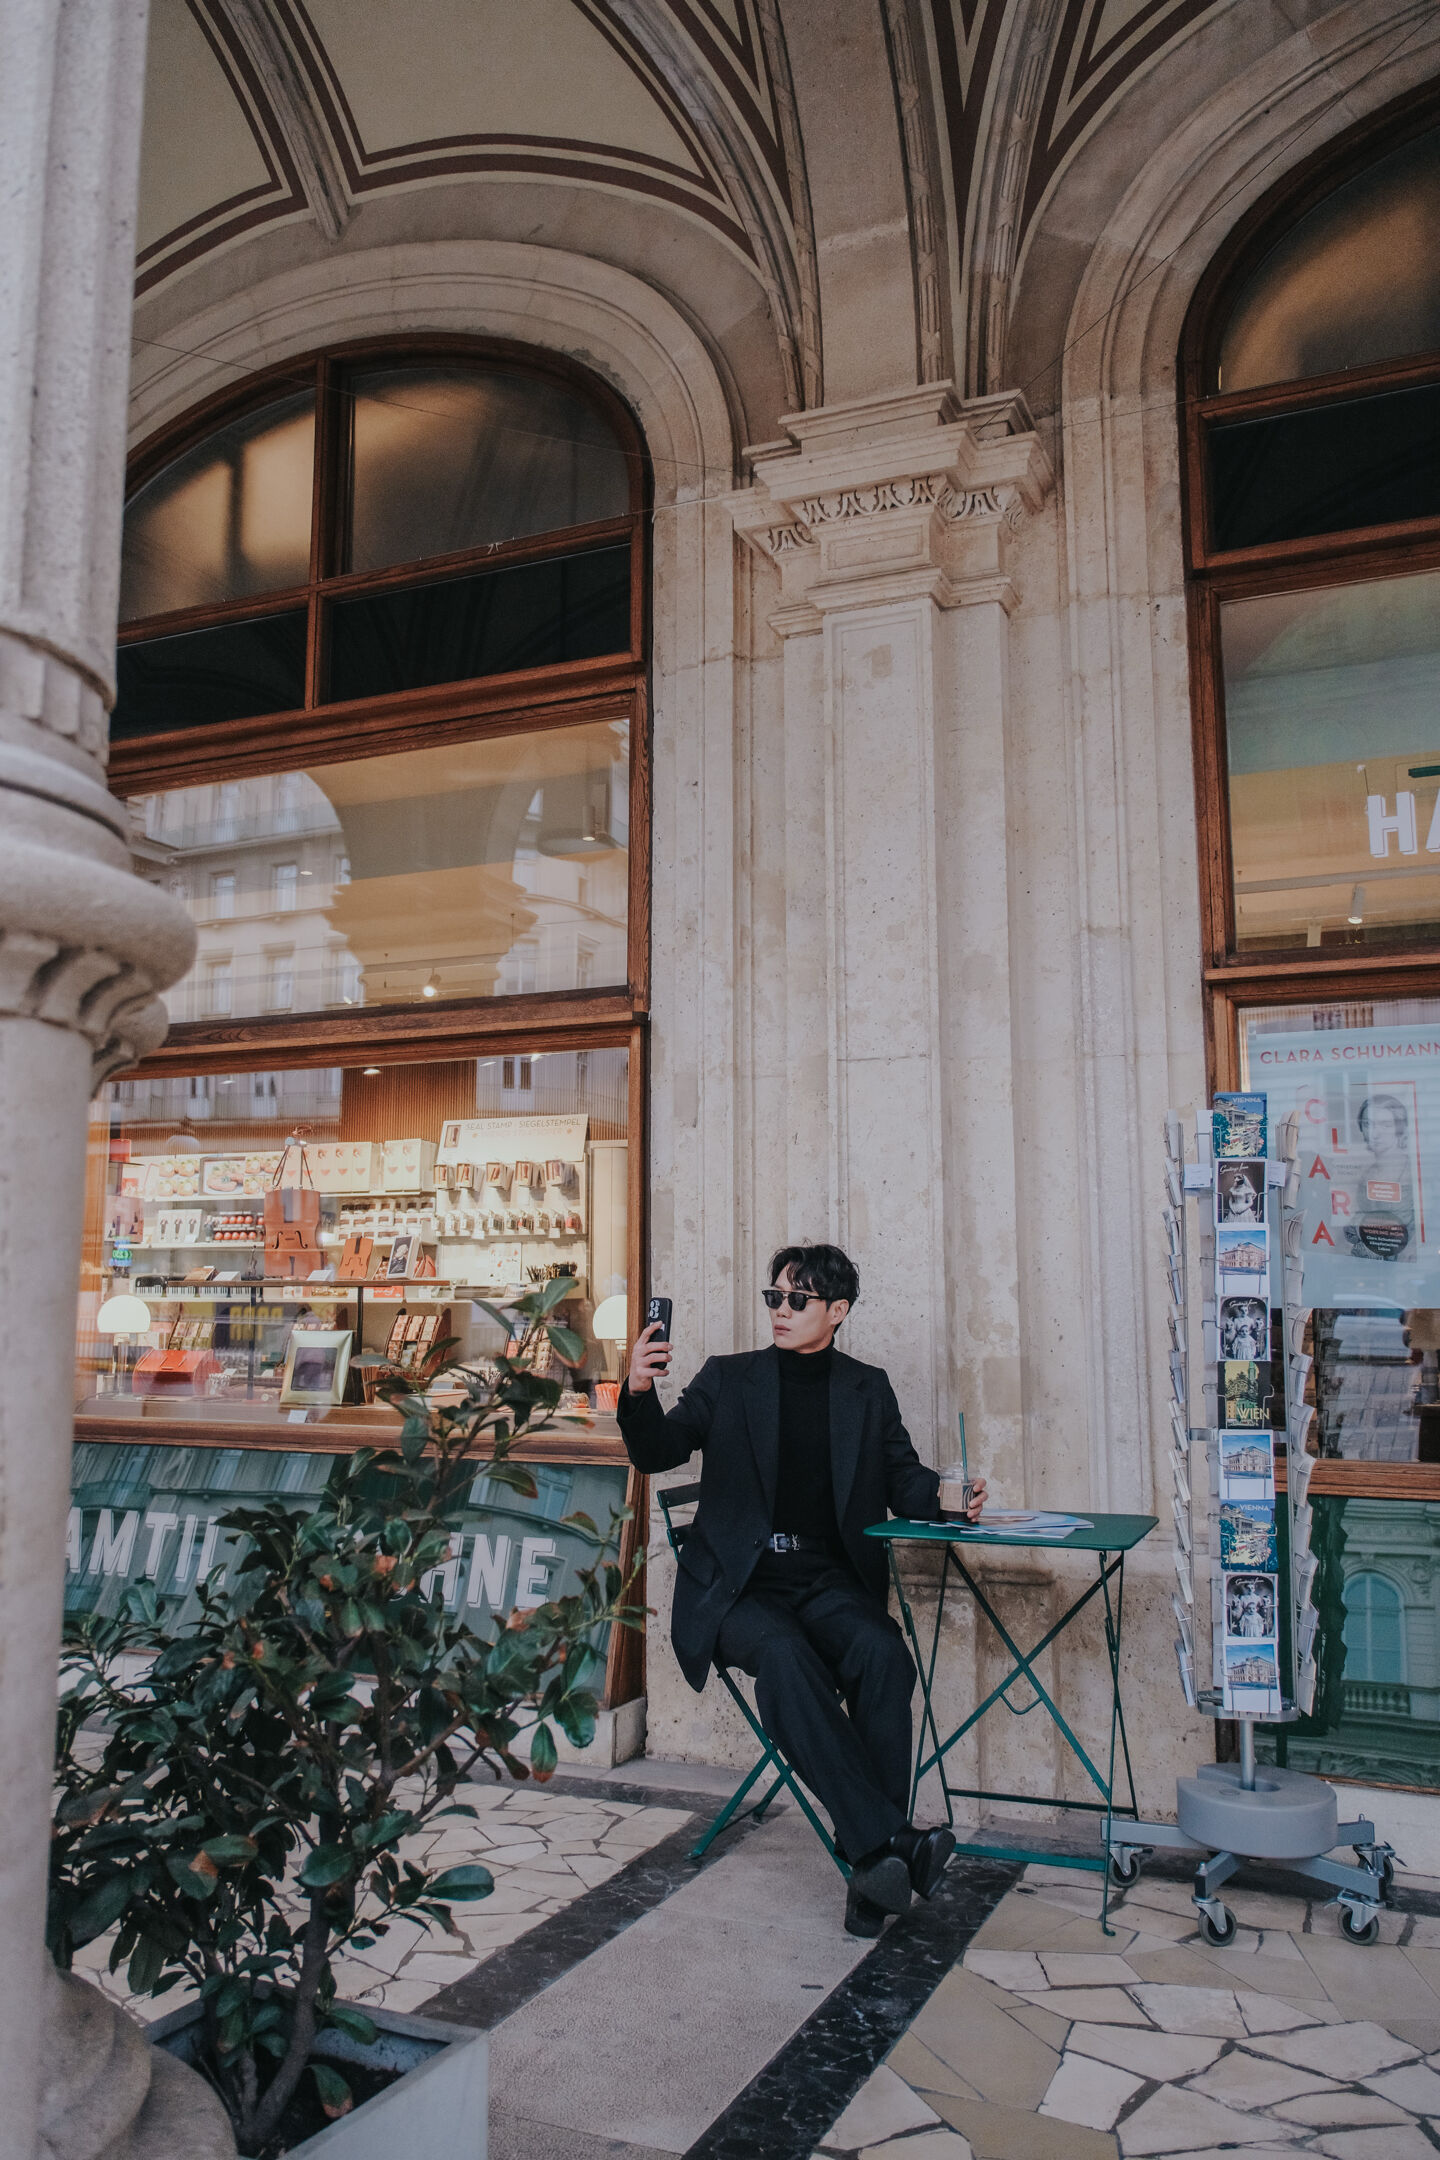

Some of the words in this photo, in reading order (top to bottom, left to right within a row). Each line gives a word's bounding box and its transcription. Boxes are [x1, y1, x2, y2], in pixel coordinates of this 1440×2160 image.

[1260, 1049, 1324, 1064] CLARA
[465, 1122, 485, 1131] SEAL
[487, 1121, 513, 1130] STAMP
[518, 1117, 581, 1128] SIEGELSTEMPEL
[1237, 1407, 1270, 1420] WIEN
[1239, 1503, 1270, 1511] VIENNA
